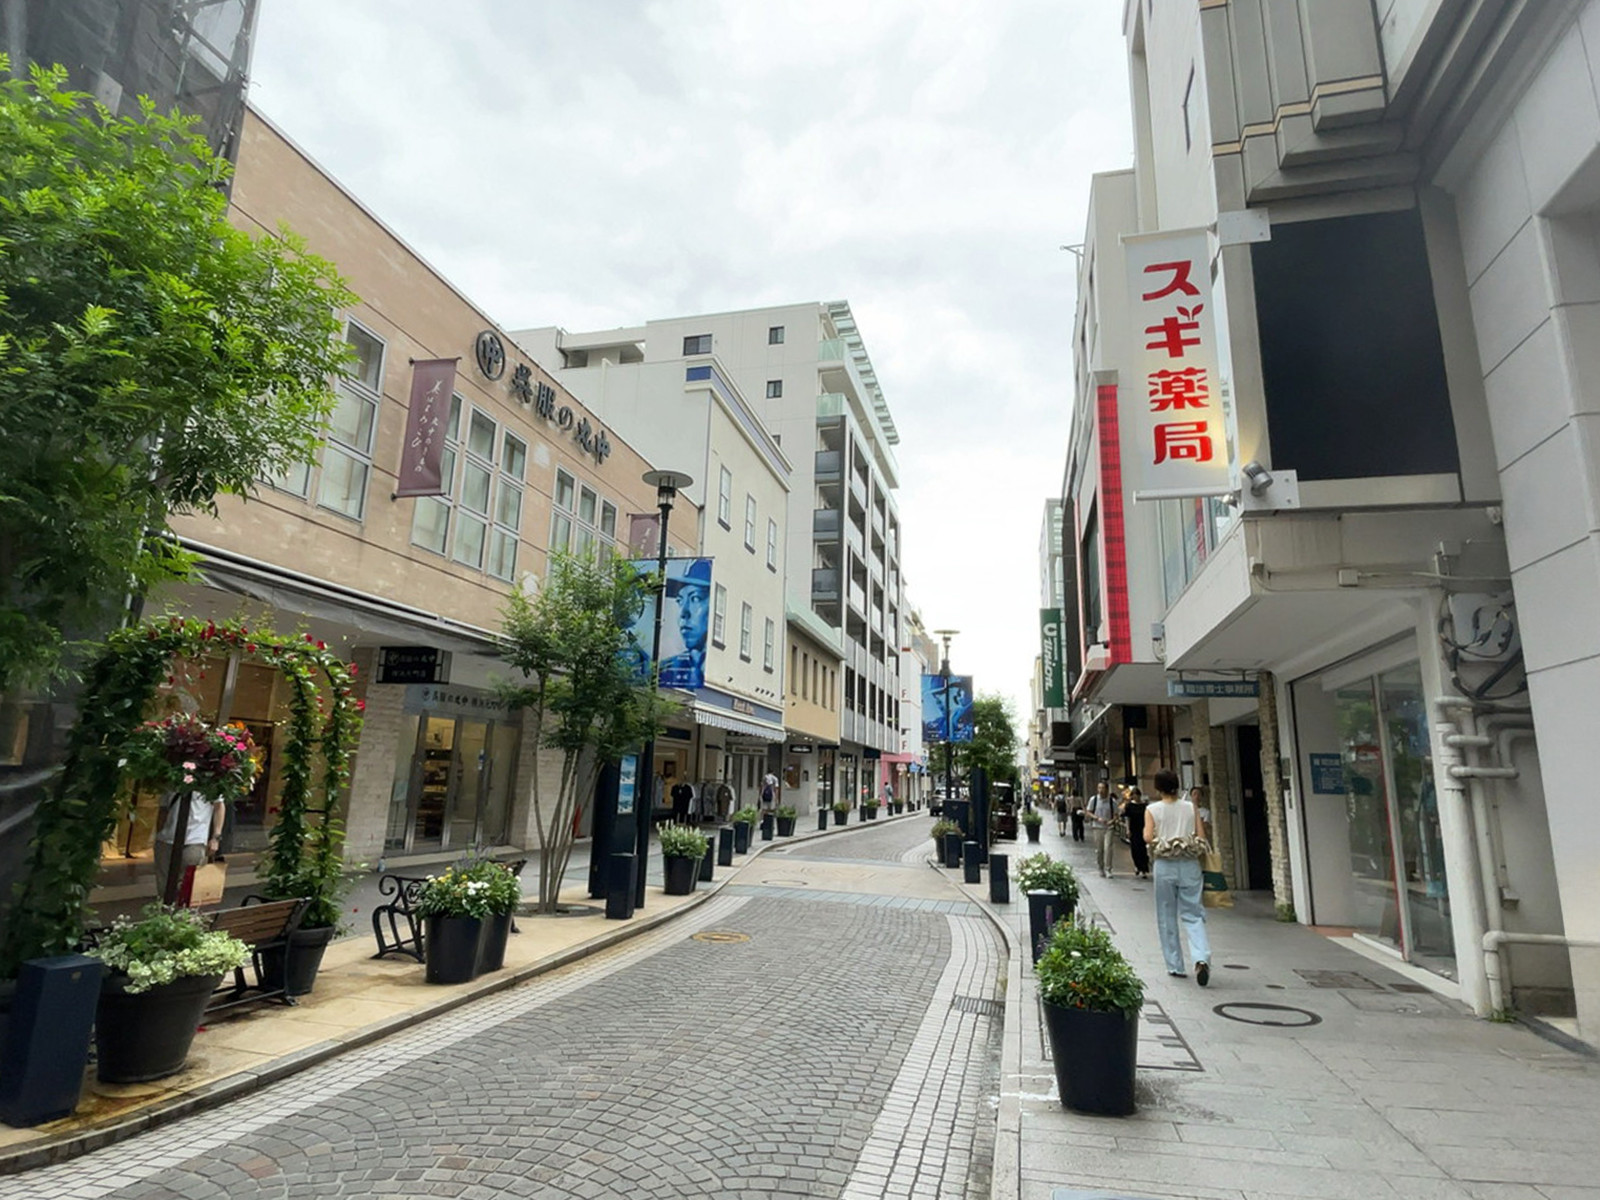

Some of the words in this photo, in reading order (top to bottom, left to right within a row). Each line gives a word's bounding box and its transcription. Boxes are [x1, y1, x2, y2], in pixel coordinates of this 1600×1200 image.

[510, 362, 611, 465] 呉服の丸中
[1142, 260, 1214, 466] スギ薬局
